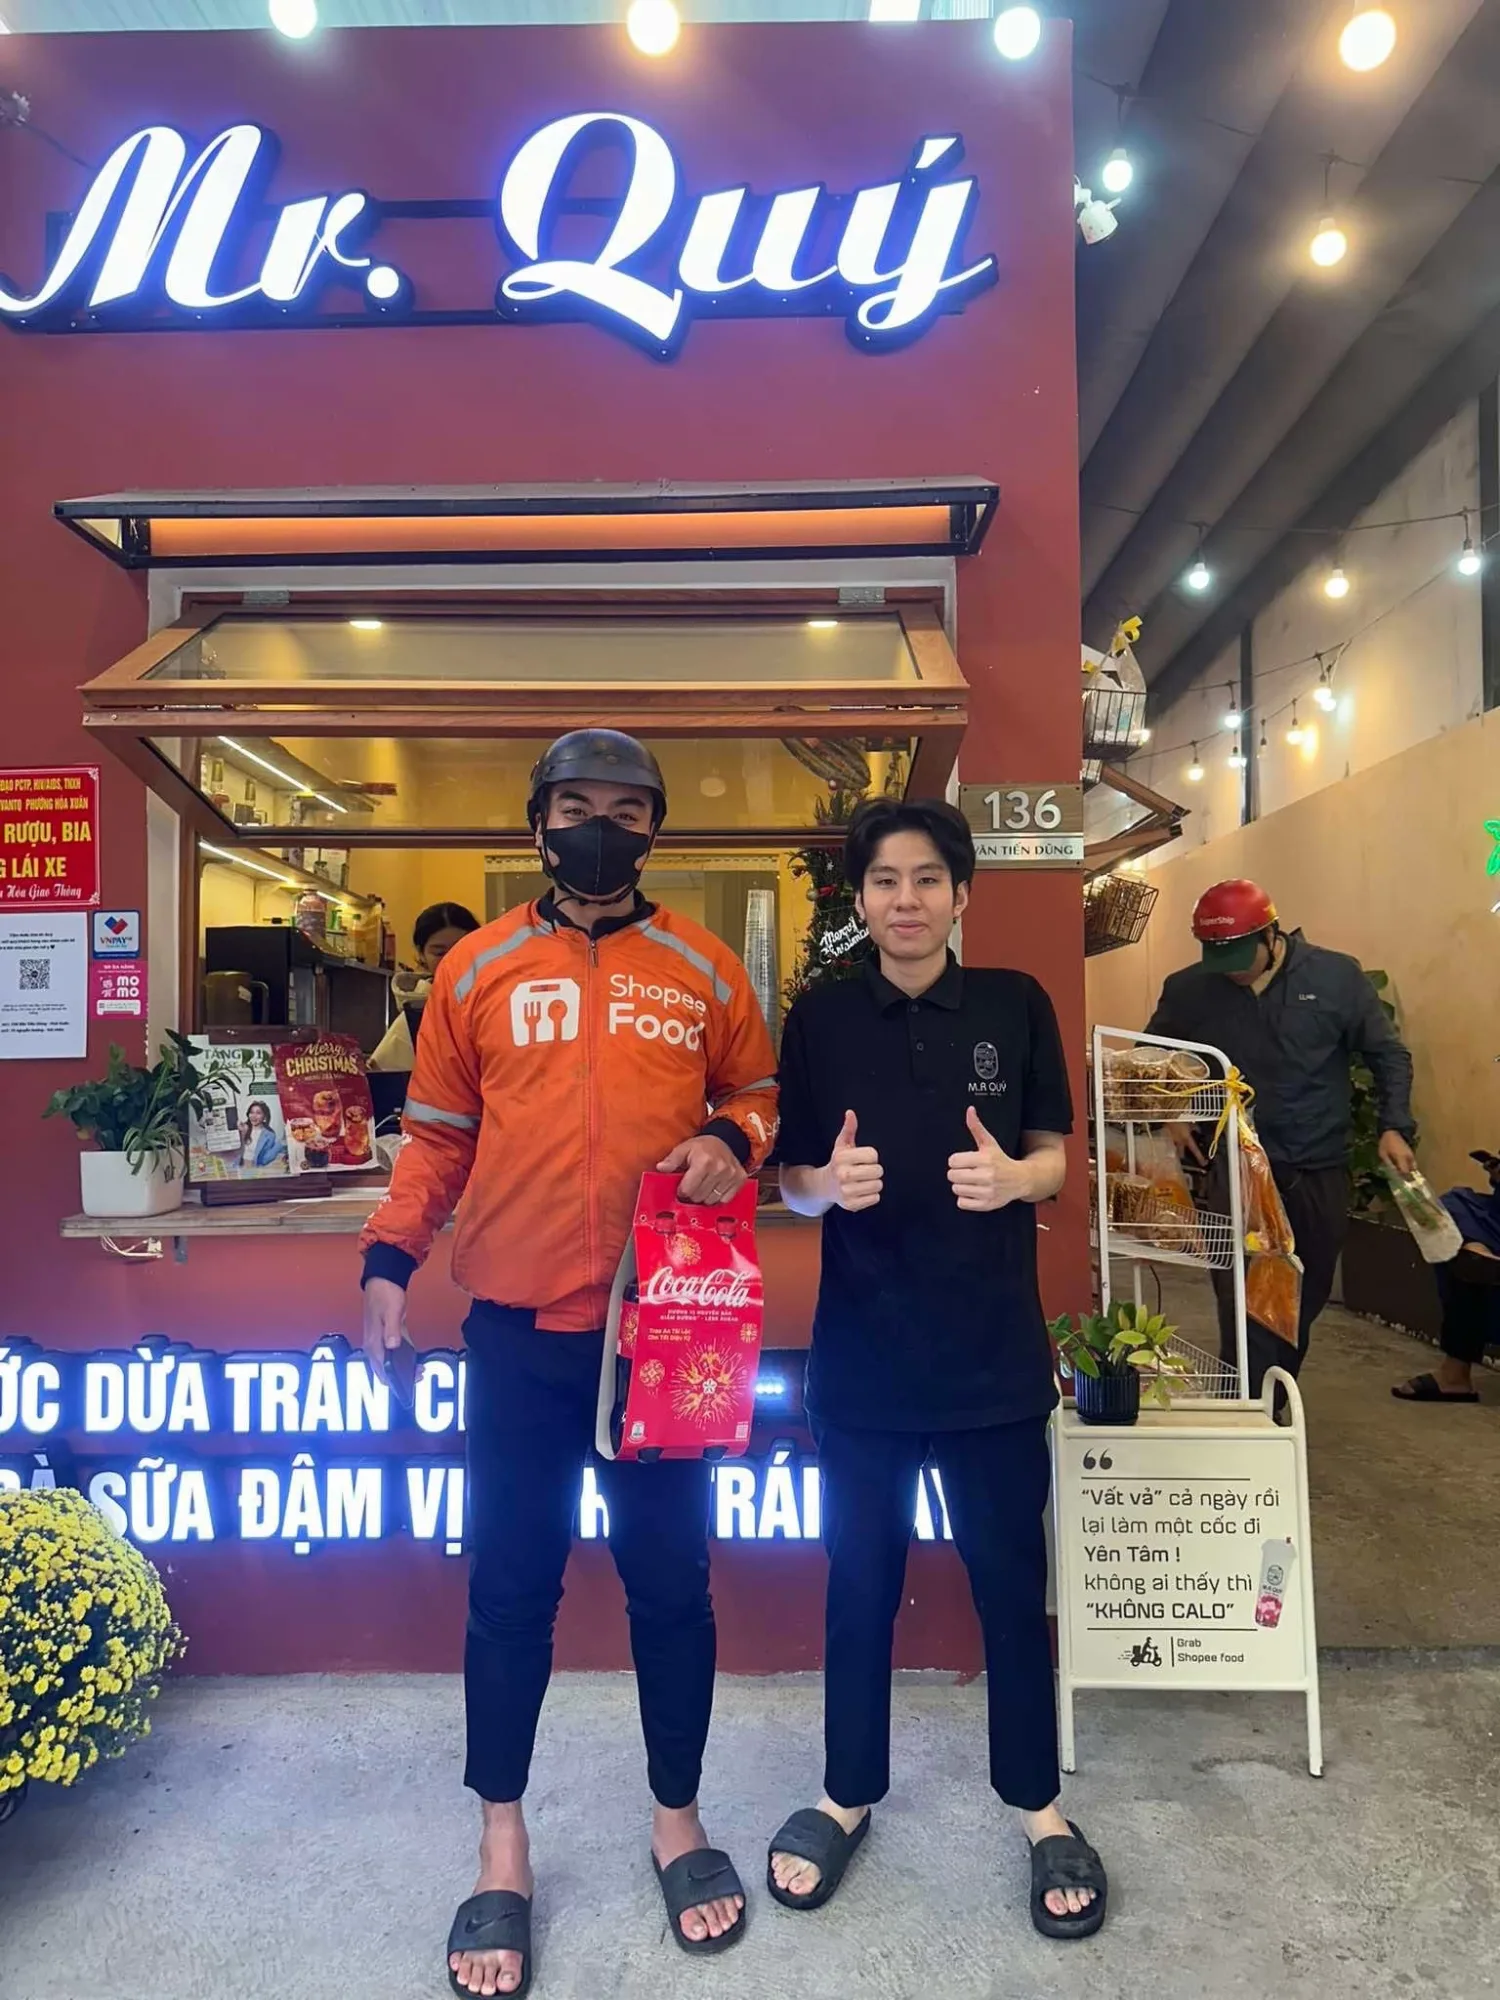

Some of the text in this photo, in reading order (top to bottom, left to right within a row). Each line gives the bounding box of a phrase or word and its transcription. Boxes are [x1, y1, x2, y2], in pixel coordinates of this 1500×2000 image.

[0, 112, 997, 342] Mr. Quý
[984, 789, 1062, 830] 136
[4, 820, 92, 847] RƯỢU, BIA
[1034, 843, 1073, 855] DŨNG
[12, 853, 39, 878] LÁI
[44, 857, 67, 877] XE
[610, 974, 707, 1017] Shopee
[609, 1002, 705, 1051] Food
[286, 1055, 358, 1077] CHRISTMAS
[85, 1348, 210, 1432] DỪA
[225, 1348, 390, 1432] TRÂN
[415, 1361, 465, 1432] C
[89, 1457, 215, 1542] SỮA
[239, 1454, 382, 1554] ĐẬM
[407, 1468, 464, 1555] VỊ
[711, 1451, 819, 1538] RÁI
[1169, 1487, 1193, 1506] cả
[1200, 1489, 1249, 1510] ngày
[1255, 1486, 1279, 1507] rồi
[1081, 1516, 1261, 1536] lại làm một cốc đi
[1084, 1545, 1121, 1562] Yên
[1127, 1545, 1169, 1562] Tâm
[1084, 1573, 1145, 1595] không
[1152, 1575, 1169, 1591] ai
[1175, 1572, 1220, 1595] thấy
[1227, 1574, 1252, 1592] thì
[1177, 1638, 1202, 1648] Grab
[1177, 1652, 1244, 1663] Shopee food
